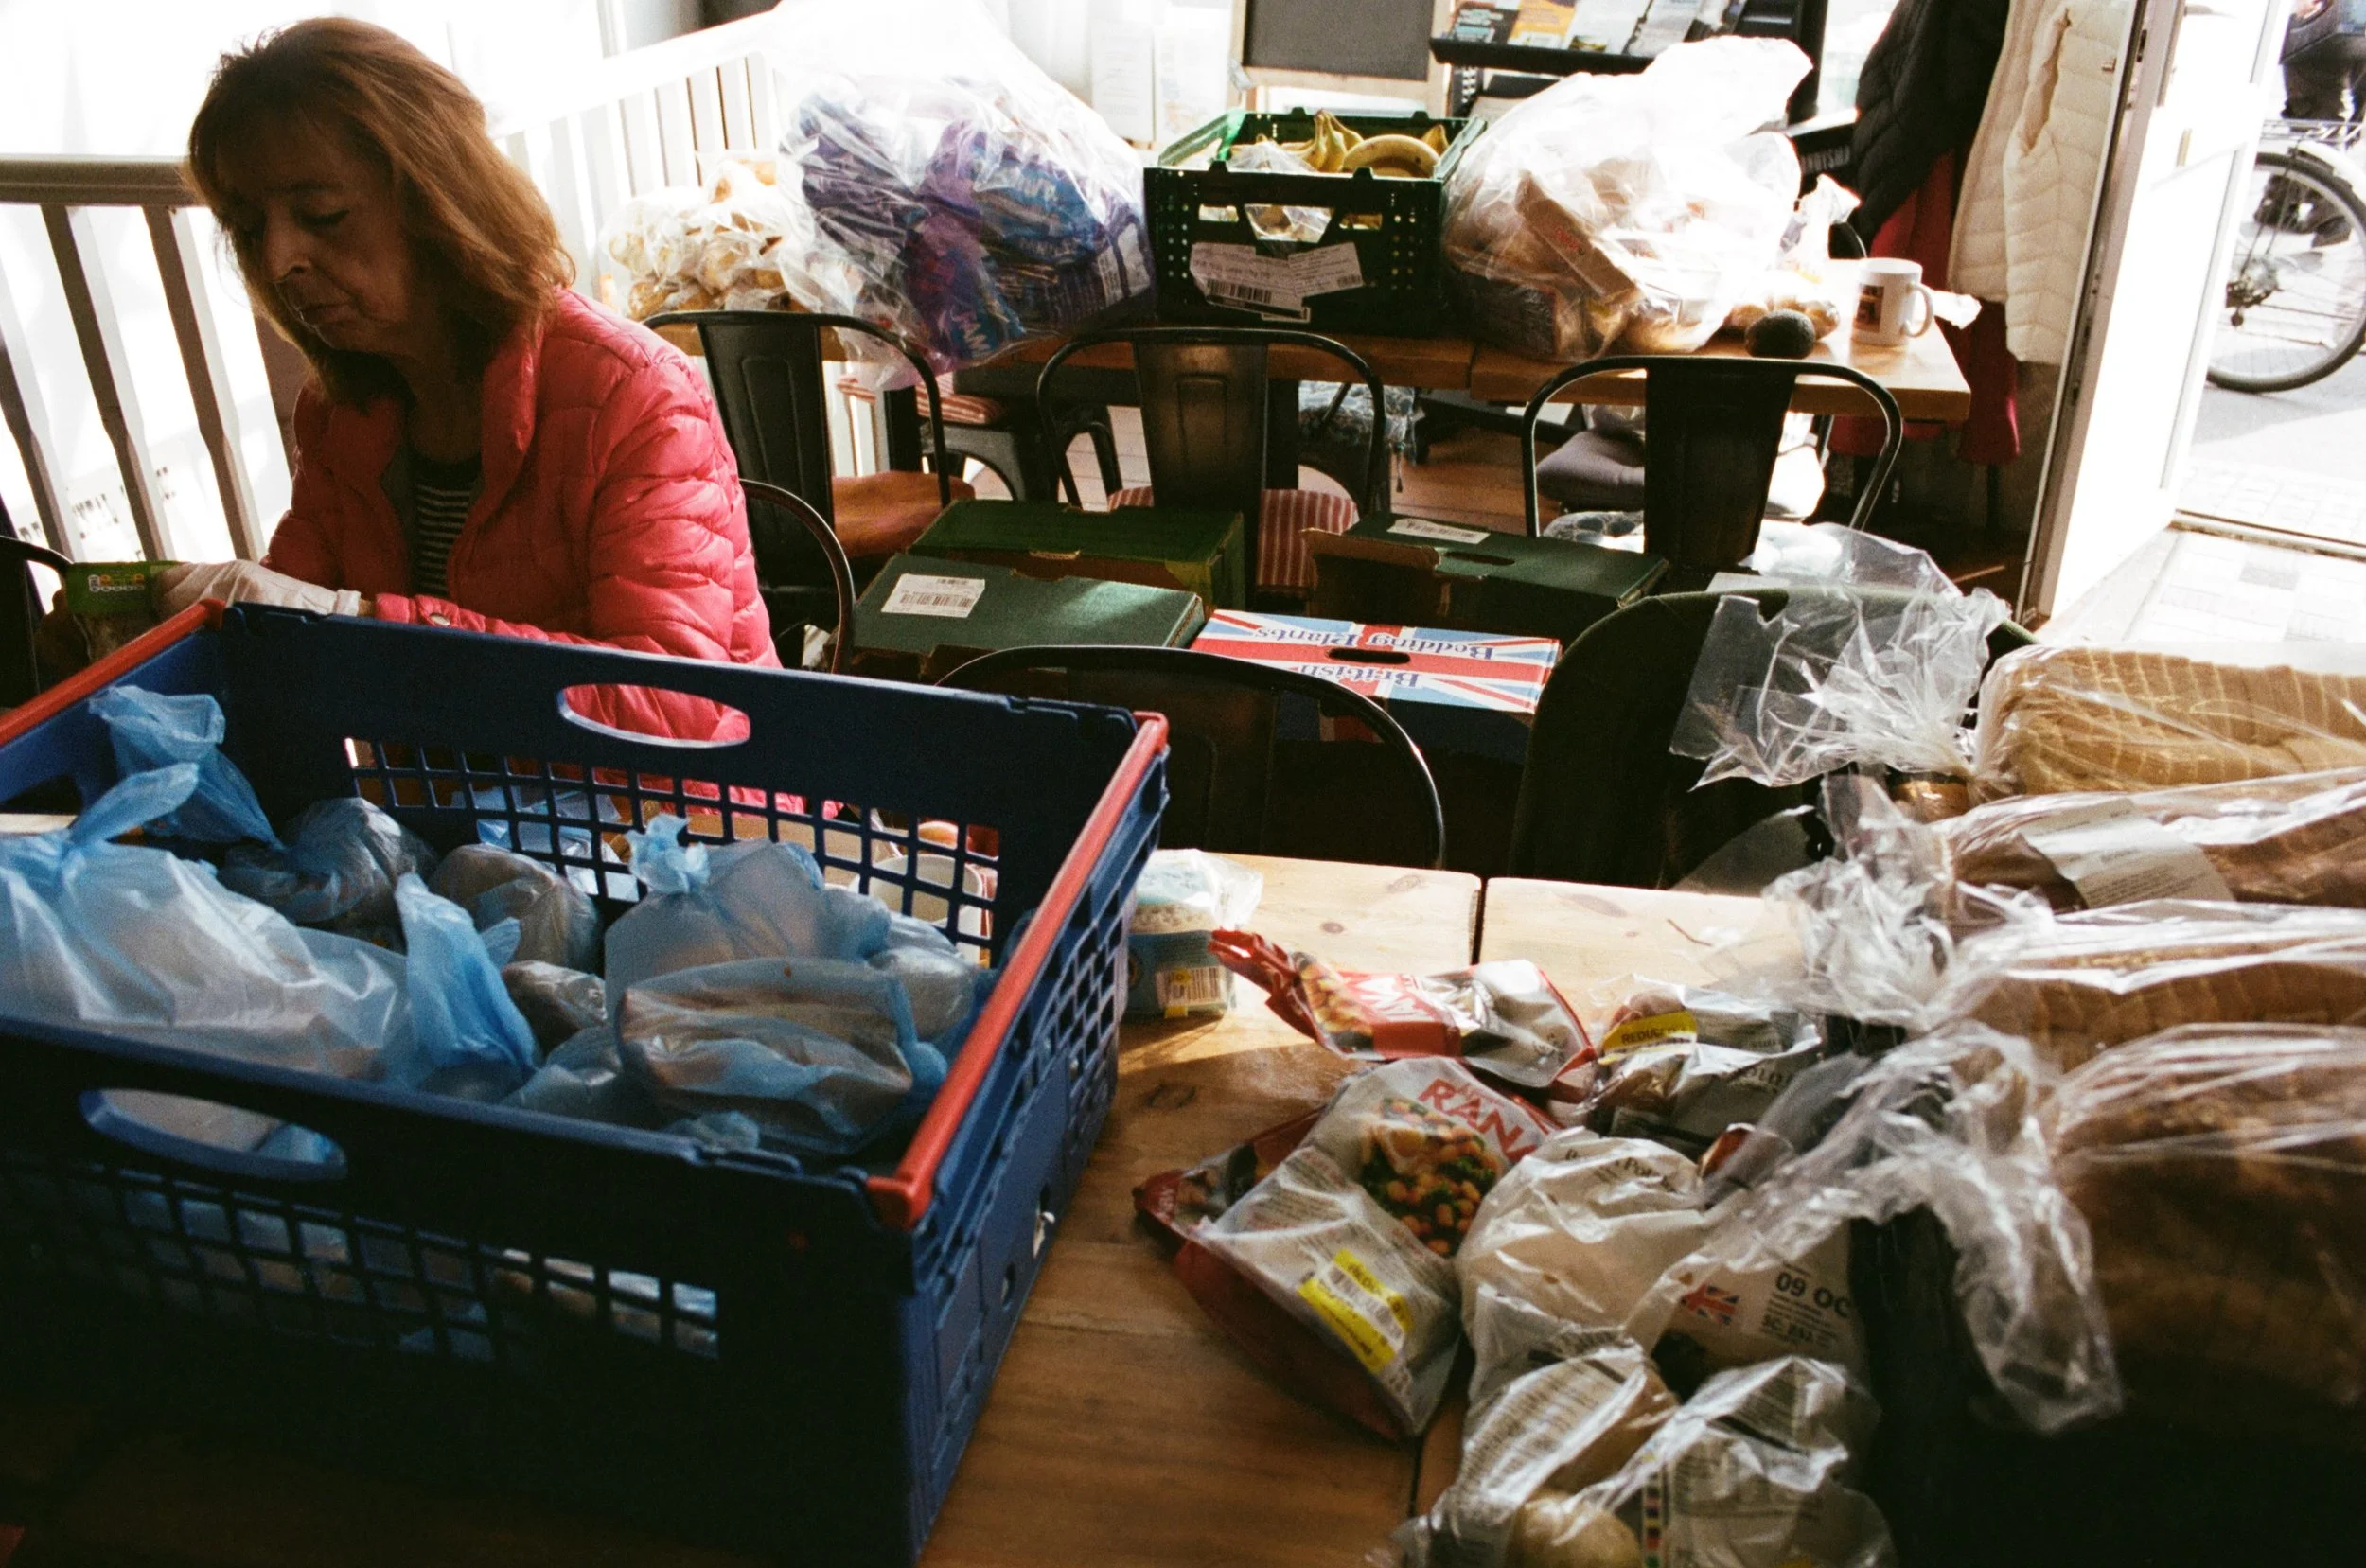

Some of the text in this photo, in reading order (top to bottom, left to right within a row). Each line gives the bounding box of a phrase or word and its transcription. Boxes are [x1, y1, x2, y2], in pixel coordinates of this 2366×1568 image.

[1255, 626, 1493, 660] Bedding Plants
[1299, 664, 1420, 689] British
[1776, 1272, 1806, 1297] 09
[1813, 1287, 1852, 1318] OC
